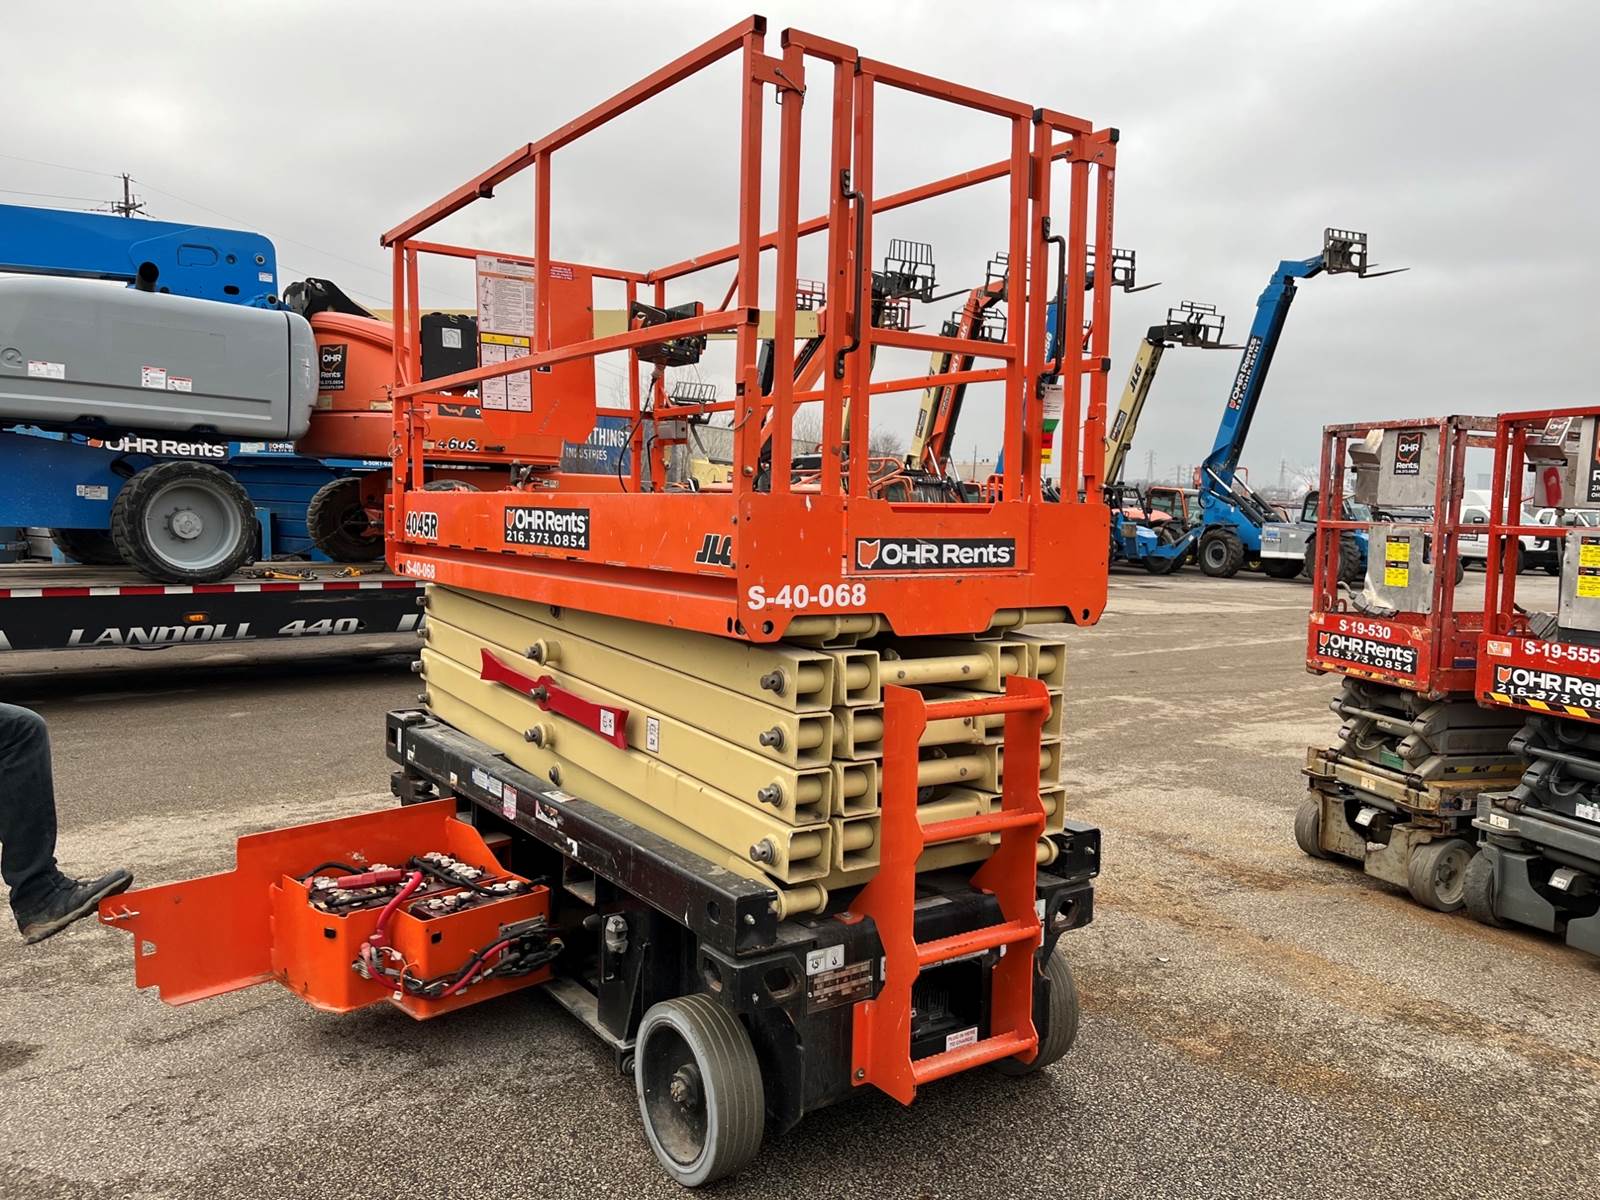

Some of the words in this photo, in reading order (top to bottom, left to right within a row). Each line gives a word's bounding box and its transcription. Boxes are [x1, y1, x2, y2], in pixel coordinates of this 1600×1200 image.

[322, 354, 342, 362] OHR
[1232, 373, 1245, 400] OHR
[1240, 338, 1257, 373] Rents
[1130, 363, 1142, 393] JLG
[161, 439, 225, 457] Rents
[1399, 443, 1420, 452] OHR
[1396, 462, 1418, 470] Rents
[404, 510, 439, 541] 4045R
[515, 508, 545, 531] OHR
[546, 509, 587, 534] Rents
[506, 530, 586, 549] 216.373.0854
[880, 542, 939, 566] OHR
[942, 542, 1010, 565] Rents
[405, 559, 436, 579] S-40-068
[746, 582, 867, 610] S-40-068
[66, 622, 257, 648] LANDOLL
[278, 617, 360, 636] 440
[1338, 619, 1392, 640] S-19-530
[1318, 646, 1413, 673] 216.373.0854
[1329, 634, 1363, 654] OHR
[1364, 641, 1413, 663] Rents
[1524, 640, 1600, 664] S-19-555
[1512, 669, 1562, 692] OHR
